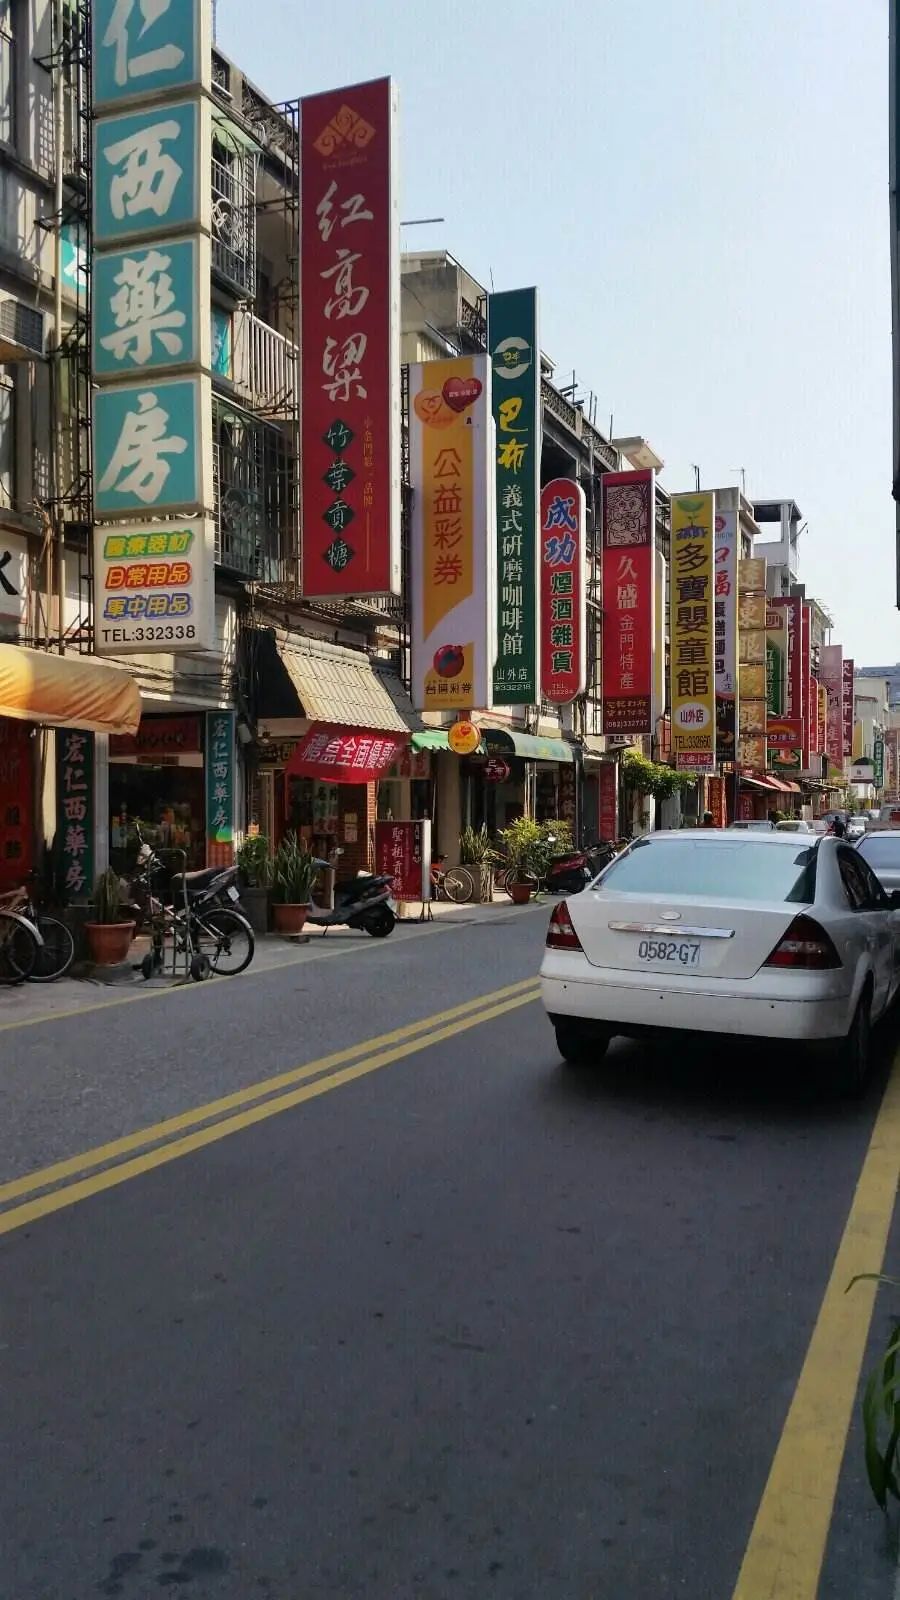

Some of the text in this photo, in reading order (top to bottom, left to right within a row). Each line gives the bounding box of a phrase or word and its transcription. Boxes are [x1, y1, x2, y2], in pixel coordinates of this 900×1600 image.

[496, 396, 529, 475] 巴布
[327, 424, 350, 567] 竹葉貢糖
[433, 446, 463, 586] 公益彩券
[544, 496, 577, 566] 成功
[104, 530, 193, 559] 醫療器材
[104, 562, 192, 590] 日常用品
[502, 484, 524, 656] 義式研磨咖啡館
[616, 555, 639, 610] 久盛
[101, 625, 196, 642] TEL:332338
[550, 572, 574, 675] 煙酒雜貨
[619, 614, 641, 690] 金門特產
[674, 542, 709, 698] 多寶嬰童館
[496, 667, 528, 681] 山外店
[680, 709, 704, 723] 山外店
[62, 733, 90, 893] 宏仁西藥房
[210, 717, 230, 833] 宏仁西藥房
